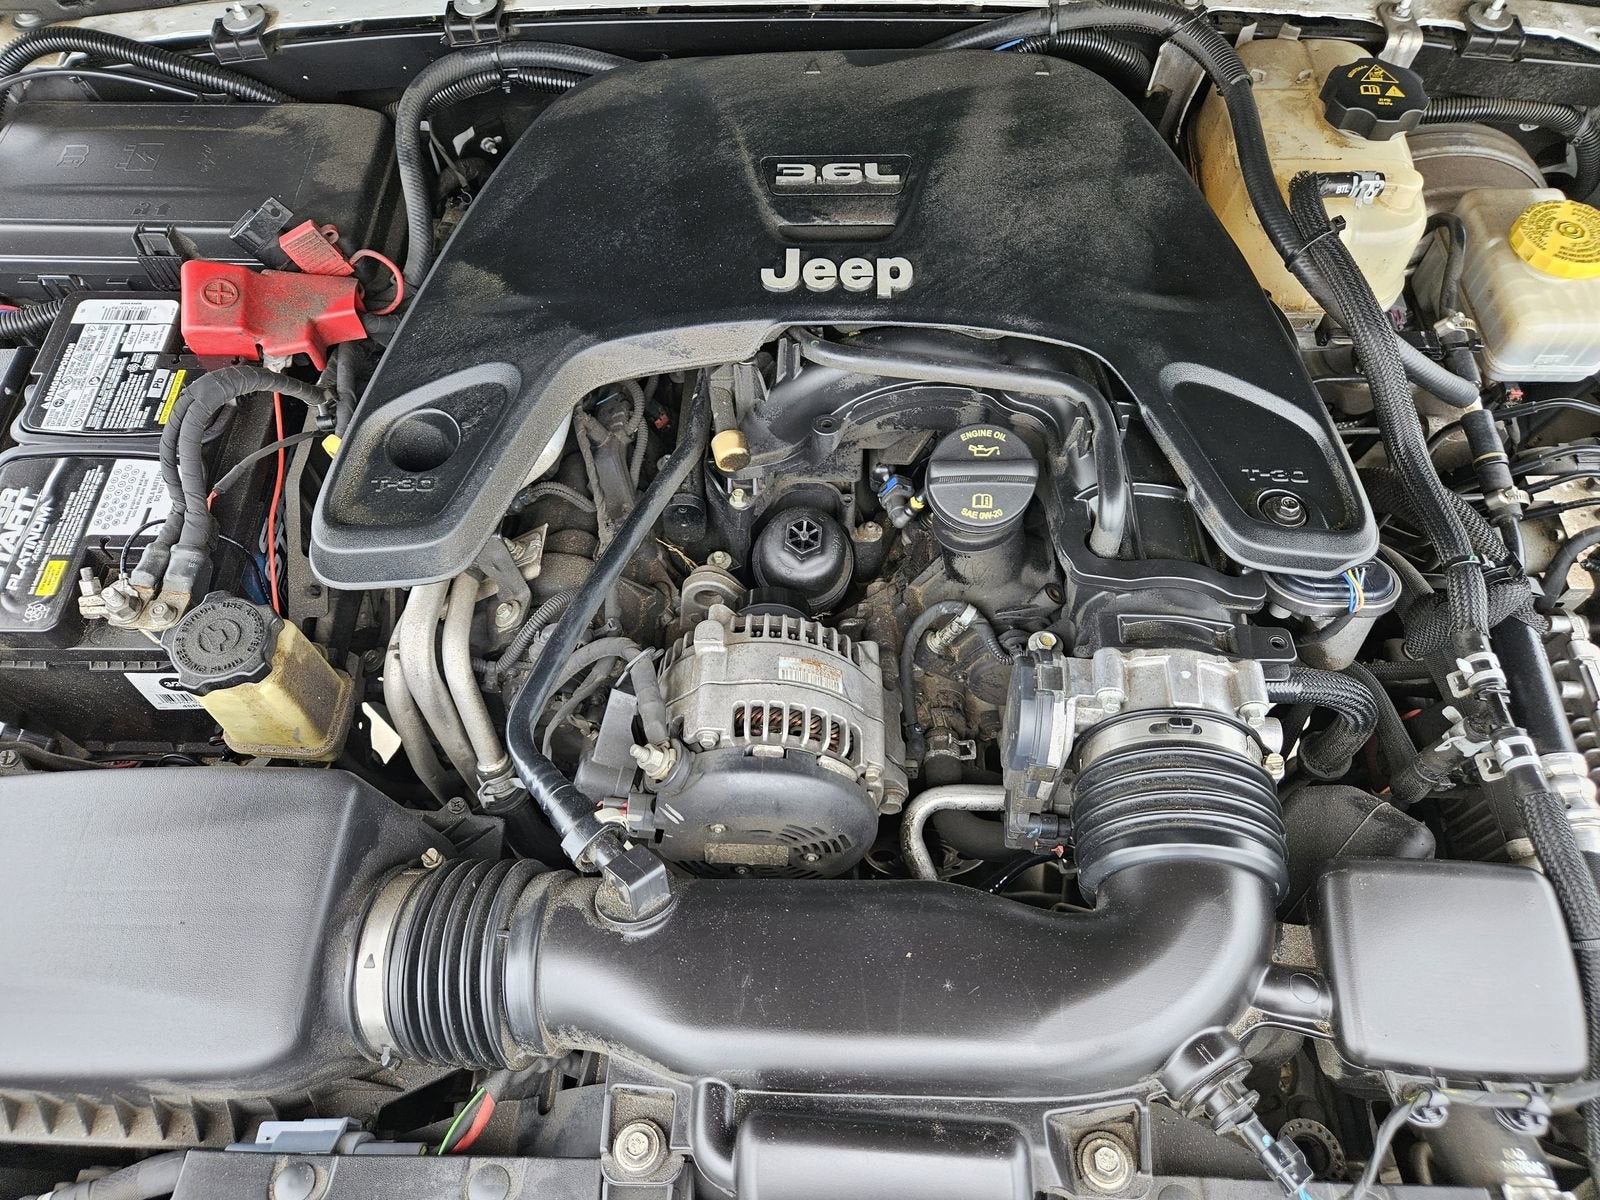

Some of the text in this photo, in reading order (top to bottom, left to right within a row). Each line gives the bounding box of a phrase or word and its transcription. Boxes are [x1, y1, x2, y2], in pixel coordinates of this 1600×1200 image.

[775, 163, 900, 185] 3.6L
[761, 248, 913, 298] Jeep
[152, 378, 164, 389] Pb
[960, 429, 1007, 442] ENGINE OIL
[1240, 468, 1309, 484] T-30
[961, 508, 1003, 519] SAE 0W-20
